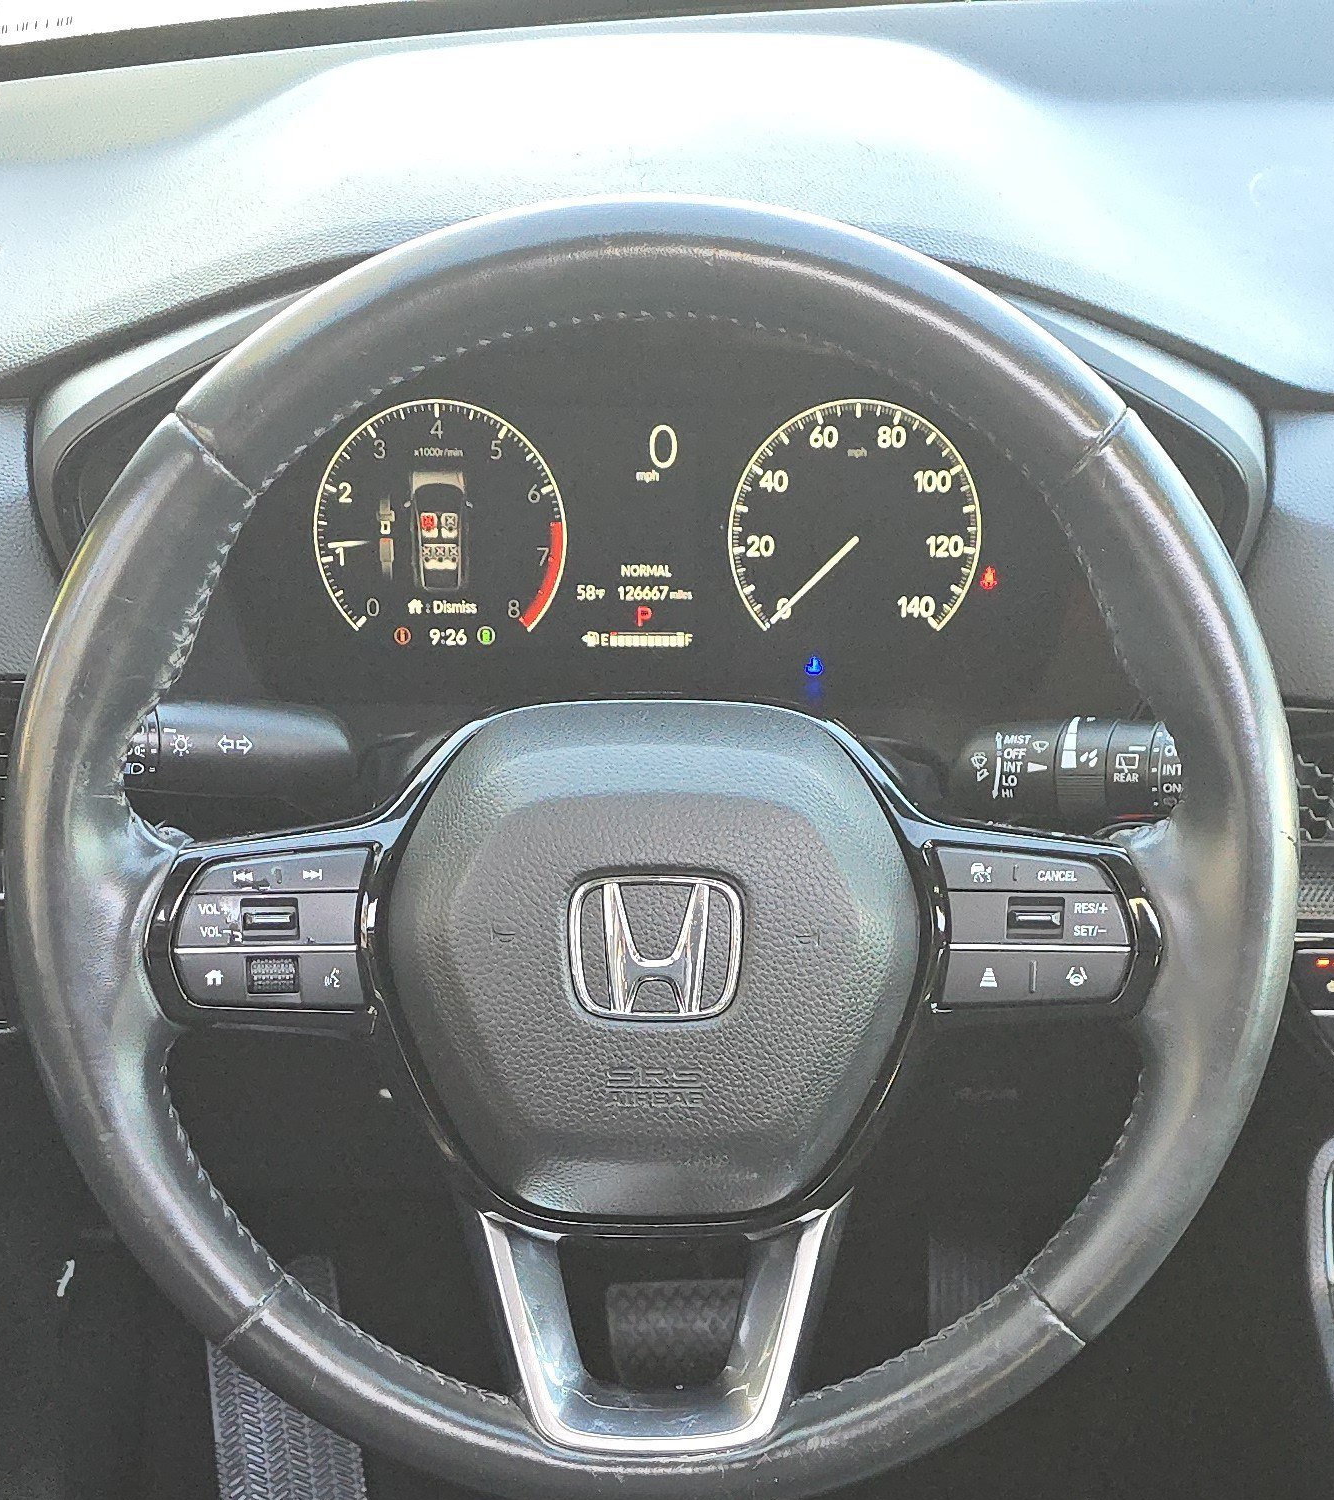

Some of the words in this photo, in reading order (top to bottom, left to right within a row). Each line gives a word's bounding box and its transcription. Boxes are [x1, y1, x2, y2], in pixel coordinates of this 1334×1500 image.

[430, 420, 443, 440] 4
[809, 425, 839, 449] 60
[877, 425, 907, 450] 80
[374, 439, 386, 460] 3
[490, 439, 503, 460] 5
[649, 424, 678, 469] 0
[759, 469, 789, 493] 40
[913, 469, 952, 493] 100
[338, 482, 353, 503] 2
[527, 483, 541, 504] 6
[746, 534, 775, 558] 20
[925, 534, 965, 558] 120
[335, 547, 345, 567] 1
[537, 547, 549, 567] 7
[620, 564, 672, 578] NORMAL
[617, 585, 670, 601] 126667
[367, 598, 380, 617] 0
[433, 600, 478, 615] Dismiss
[507, 599, 521, 619] 8
[637, 605, 653, 627] P
[897, 595, 936, 619] 140
[429, 628, 468, 646] 9:26
[1003, 734, 1031, 745] MIST
[1003, 748, 1027, 760] OFF
[1003, 761, 1023, 773] INT
[1002, 774, 1017, 786] LO
[1113, 772, 1139, 783] REAR
[1001, 789, 1013, 799] HI
[1162, 783, 1182, 794] ON
[1037, 870, 1078, 882] CANCEL
[606, 1066, 702, 1087] SRS
